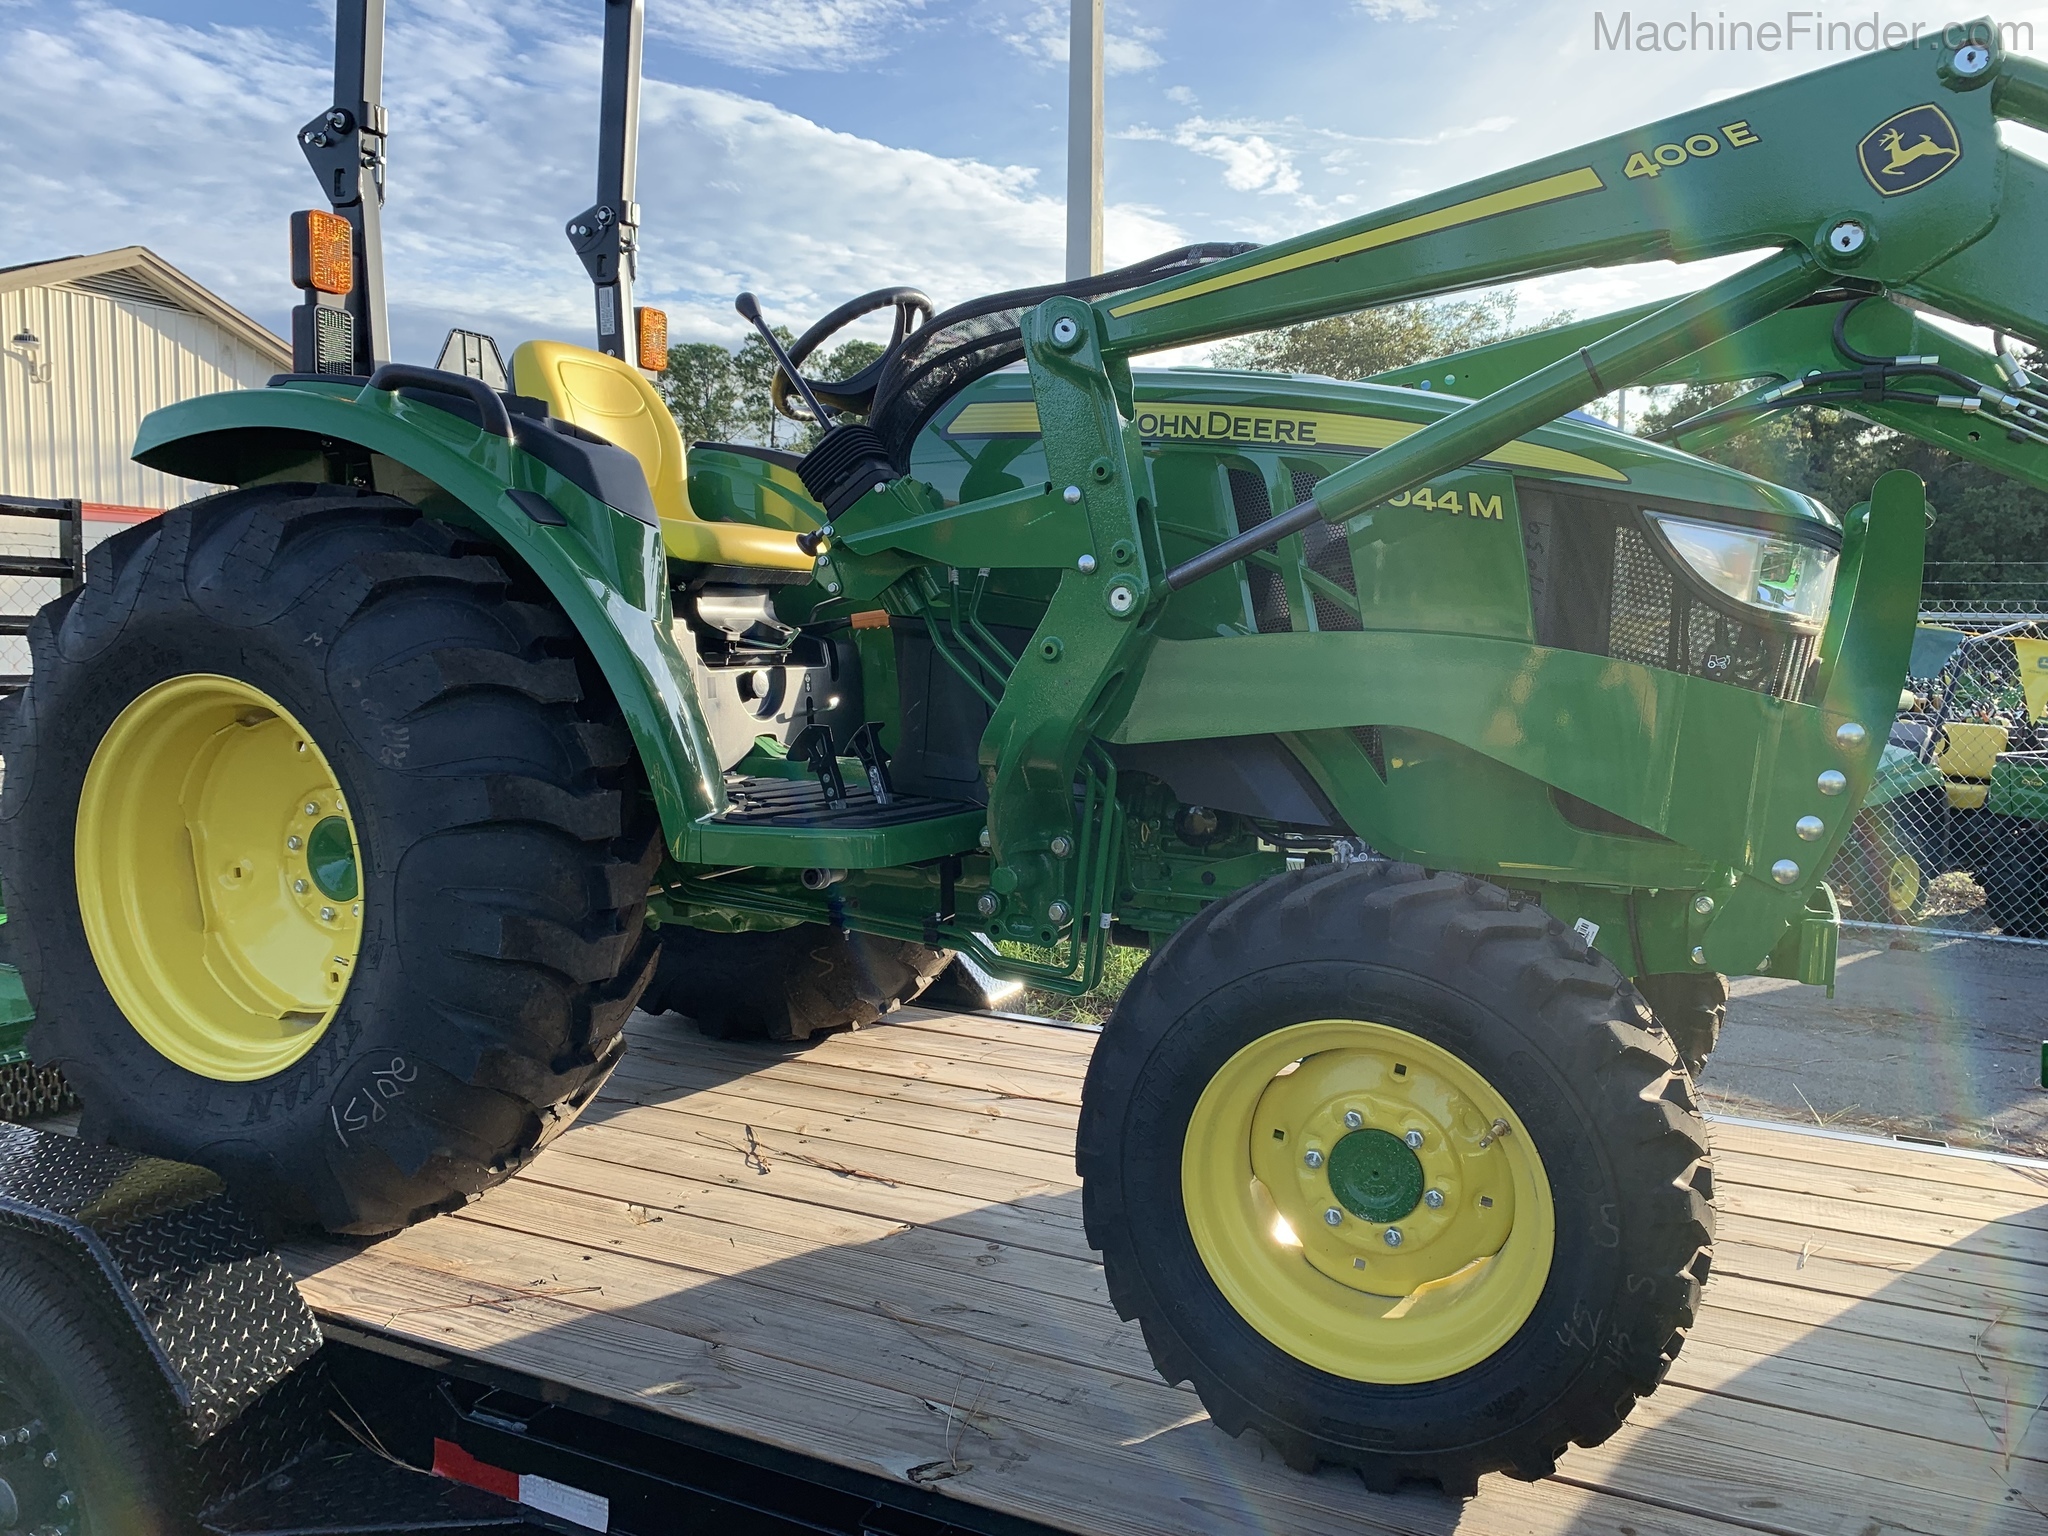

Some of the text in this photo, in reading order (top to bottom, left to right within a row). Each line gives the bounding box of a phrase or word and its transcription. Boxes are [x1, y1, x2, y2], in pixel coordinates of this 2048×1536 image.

[1623, 120, 1760, 180] 400 E
[1136, 409, 1317, 444] OHN DEERE
[1469, 492, 1503, 520] M
